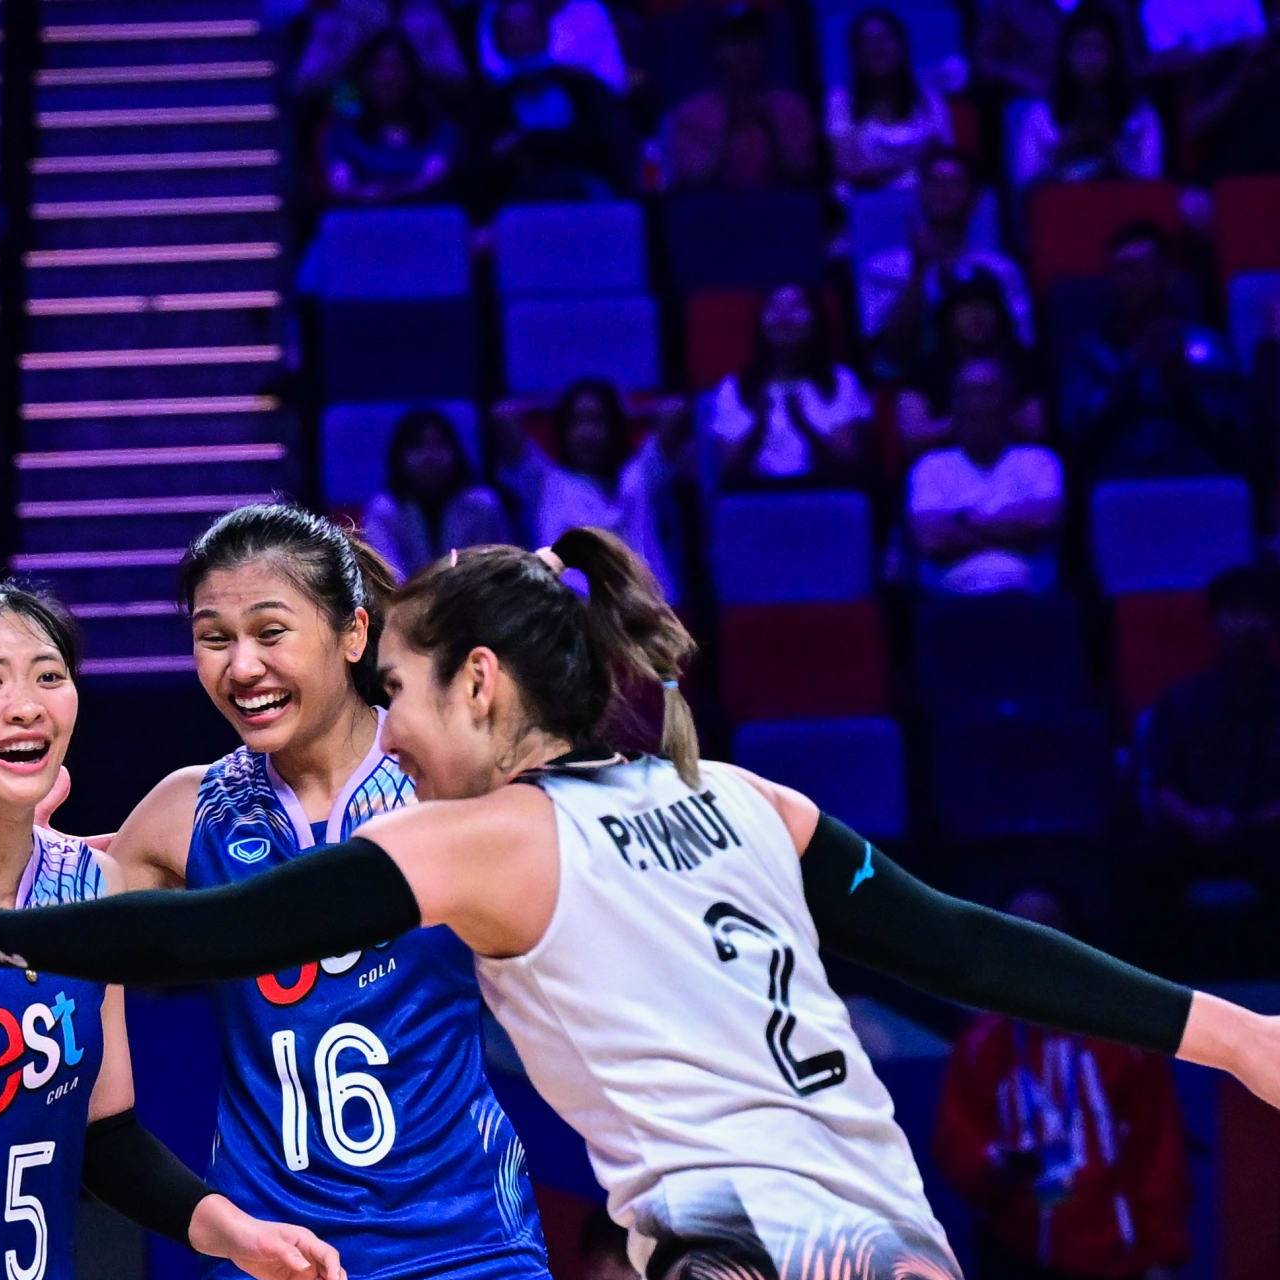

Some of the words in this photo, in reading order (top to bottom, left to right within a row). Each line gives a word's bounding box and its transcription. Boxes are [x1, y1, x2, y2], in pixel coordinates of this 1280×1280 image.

[358, 957, 396, 989] COLA
[704, 902, 847, 1096] 2
[46, 1076, 79, 1105] COLA
[272, 1022, 397, 1172] 16
